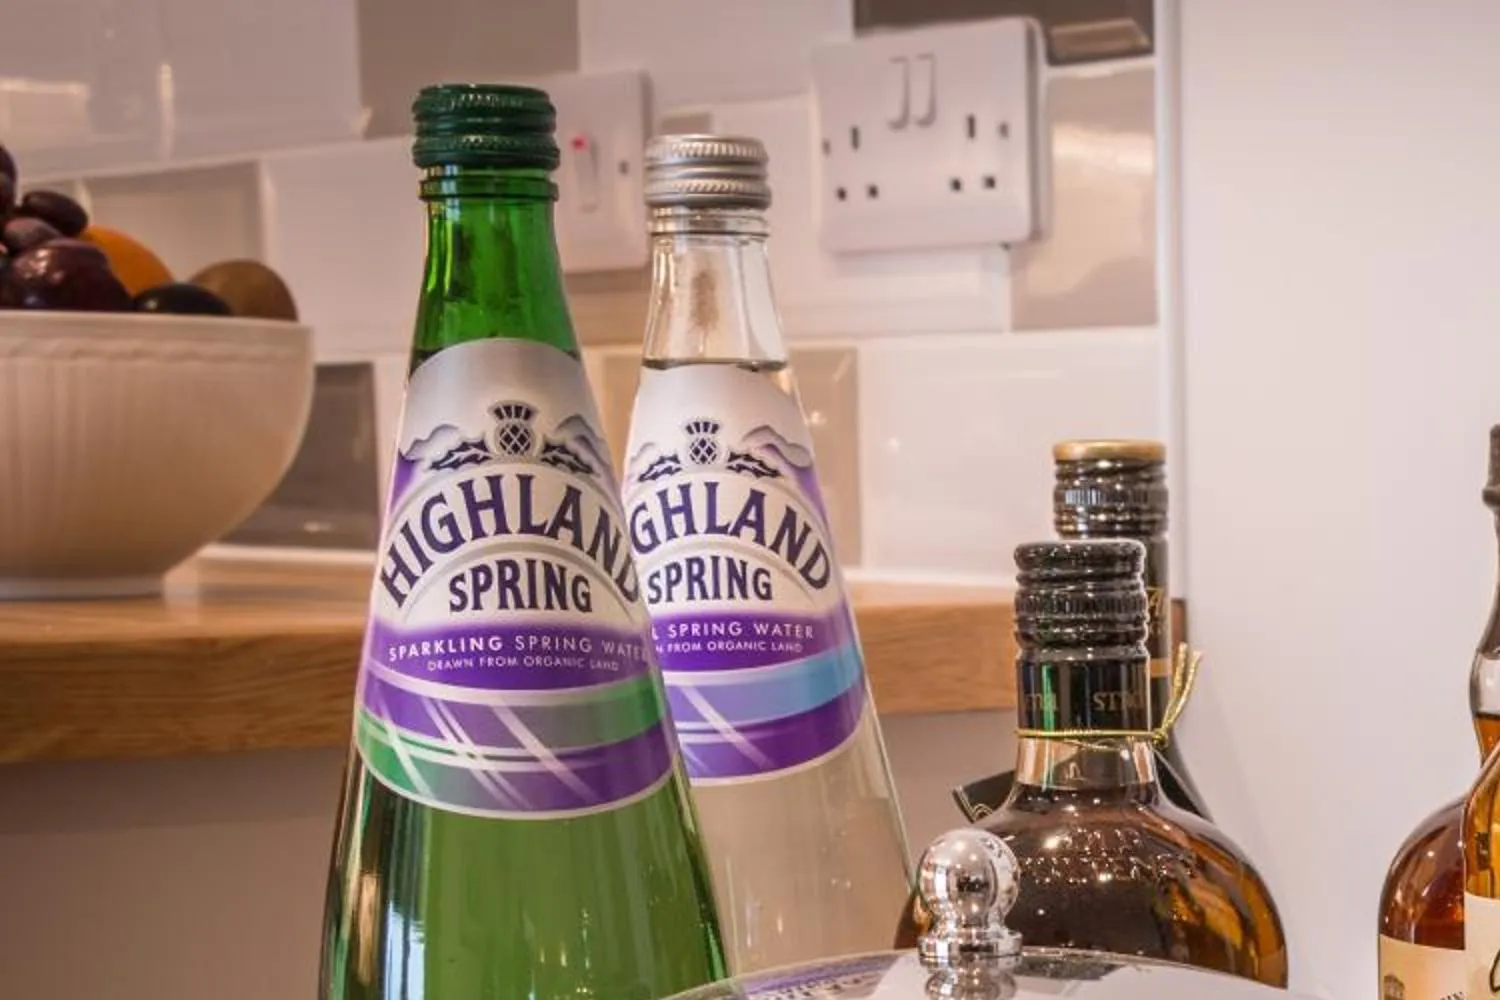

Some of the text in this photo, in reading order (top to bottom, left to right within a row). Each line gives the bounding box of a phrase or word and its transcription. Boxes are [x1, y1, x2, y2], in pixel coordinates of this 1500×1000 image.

[379, 474, 639, 609] HIGHLAND
[630, 481, 830, 590] GHLAND
[449, 558, 593, 614] SPRING
[647, 555, 773, 605] SPRING
[388, 635, 503, 663] SPARKLING
[514, 635, 593, 653] SPRING
[667, 621, 744, 640] SPRING
[753, 622, 814, 639] WATER
[667, 642, 701, 653] FROM
[706, 640, 767, 653] ORGANIC
[479, 656, 518, 669] FROM
[522, 655, 586, 669] ORGANIC
